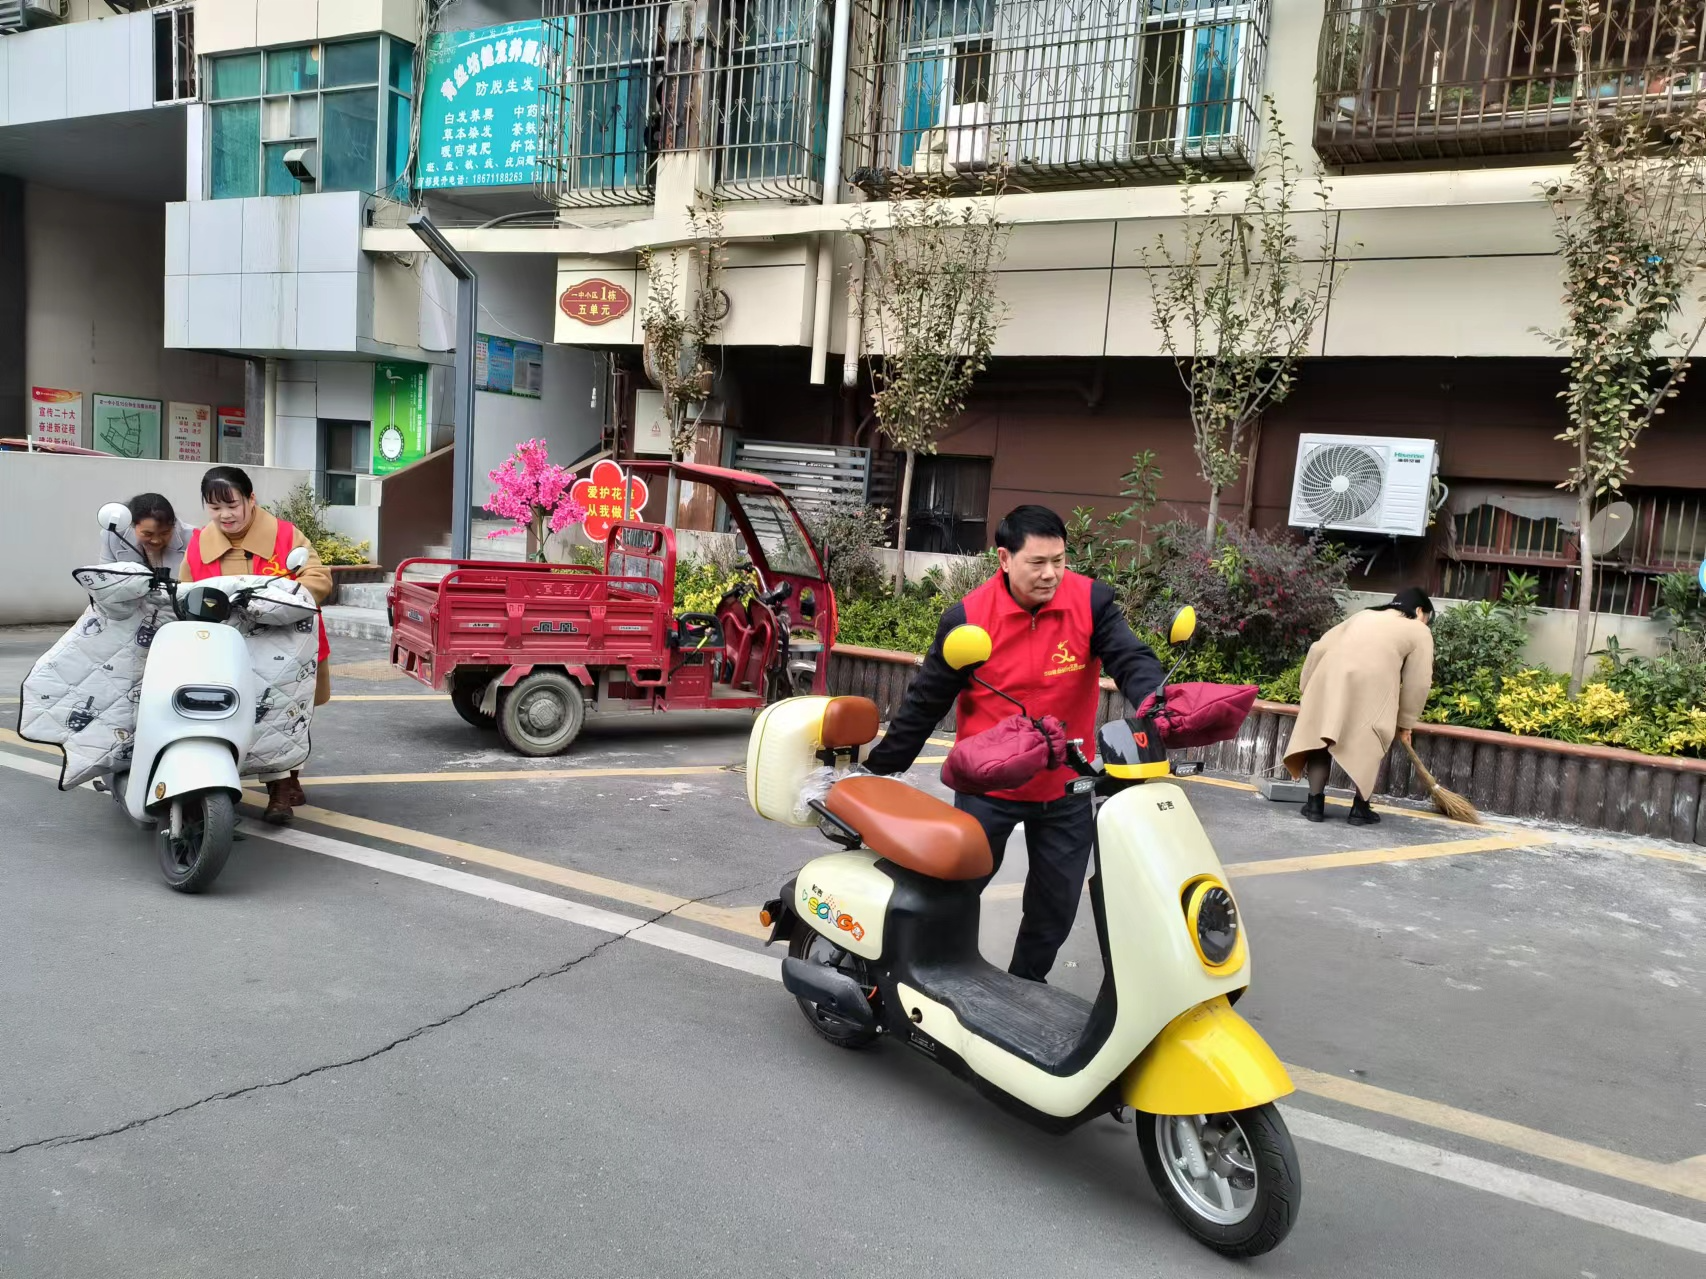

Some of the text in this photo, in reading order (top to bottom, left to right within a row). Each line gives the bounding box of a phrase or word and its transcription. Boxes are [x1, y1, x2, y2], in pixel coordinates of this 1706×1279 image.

[475, 76, 535, 97] 防脱生发
[444, 108, 495, 125] 白发养黑
[442, 124, 493, 142] 草本染发
[578, 304, 611, 316] 五单元
[39, 407, 76, 419] 宣传二十大
[39, 422, 76, 434] 奋进新征程
